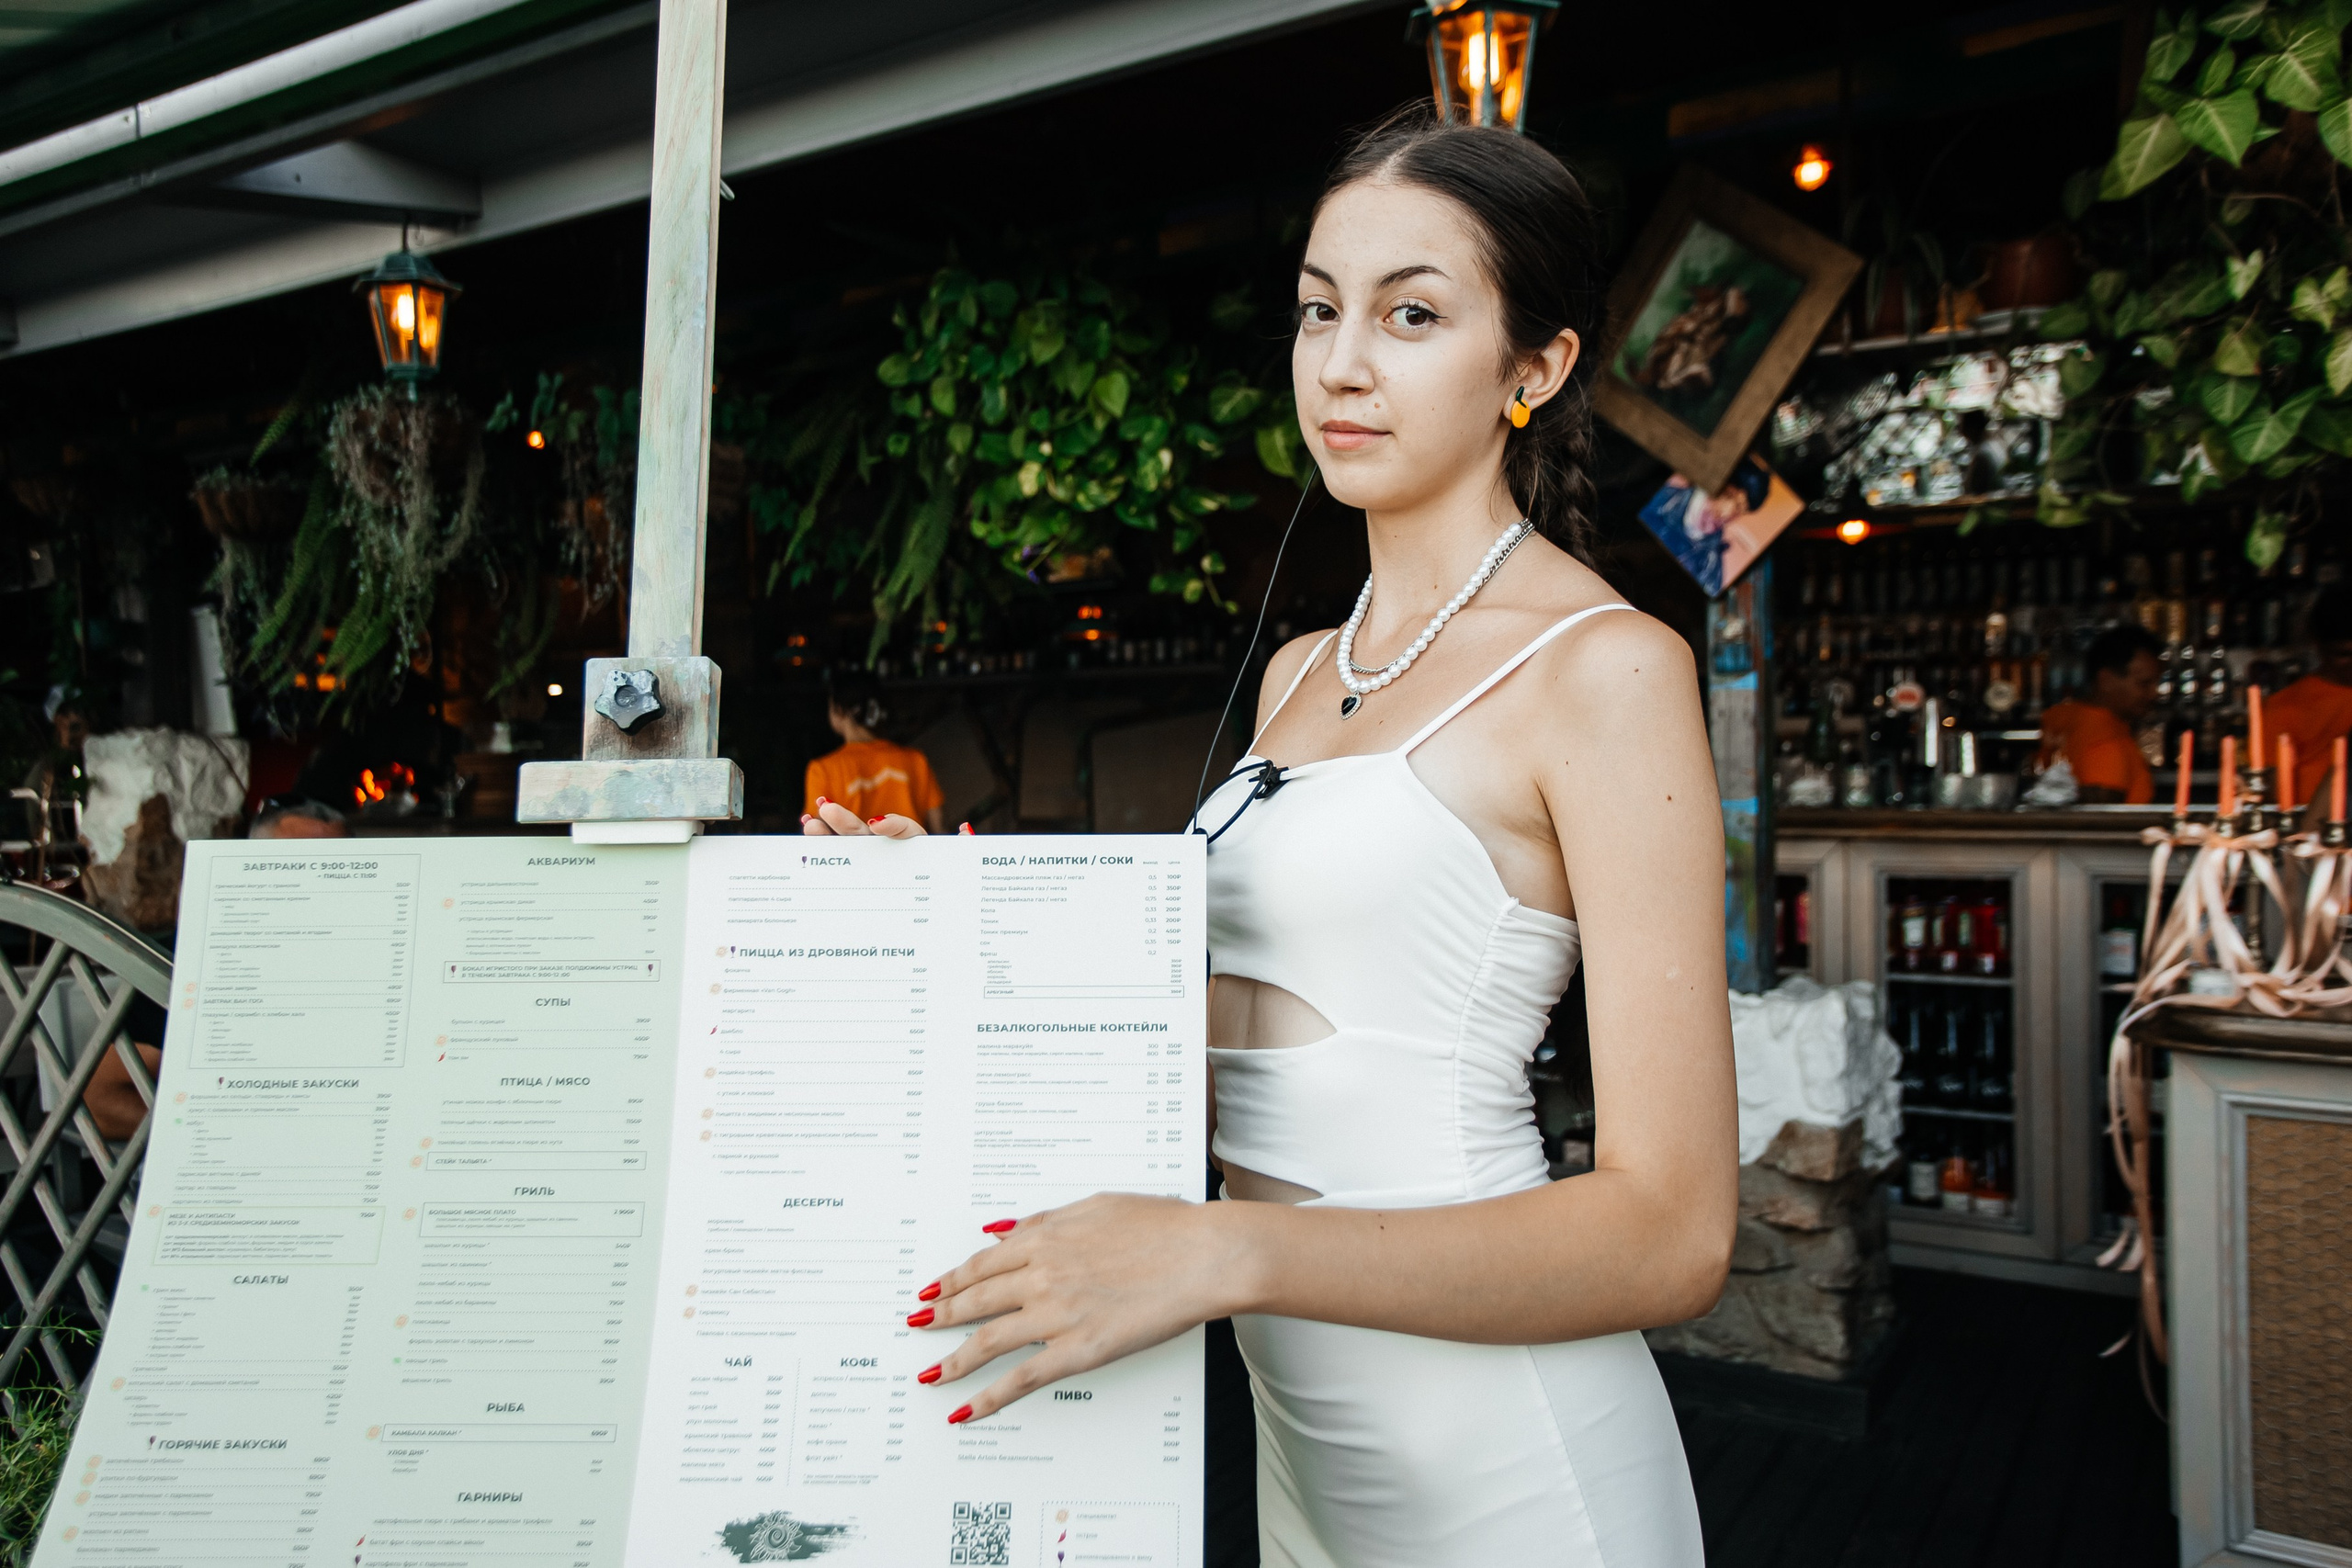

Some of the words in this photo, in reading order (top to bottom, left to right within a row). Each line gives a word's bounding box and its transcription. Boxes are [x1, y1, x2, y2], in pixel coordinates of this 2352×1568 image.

[982, 857, 1017, 866] ВОДА
[243, 863, 306, 871] ЗАВТРАКИ
[740, 949, 785, 958] ПИЦЦА
[808, 947, 877, 957] ДРОВЯНОЙ
[1101, 1021, 1168, 1032] КОКТЕЙЛИ
[228, 1080, 300, 1089] ХОЛОДНЫЕ
[501, 1078, 543, 1087] ПТИЦА
[783, 1199, 843, 1208] ДЕСЕРТЫ
[725, 1358, 752, 1366] ЧАЙ
[841, 1359, 878, 1367] КОФЕ
[1055, 1391, 1092, 1400] ПИВО
[487, 1404, 526, 1412] РЫБА
[158, 1440, 220, 1449] ГОРЯЧИЕ
[224, 1440, 288, 1449] ЗАКУСКИ
[458, 1493, 523, 1502] ГАРНИРЫ
